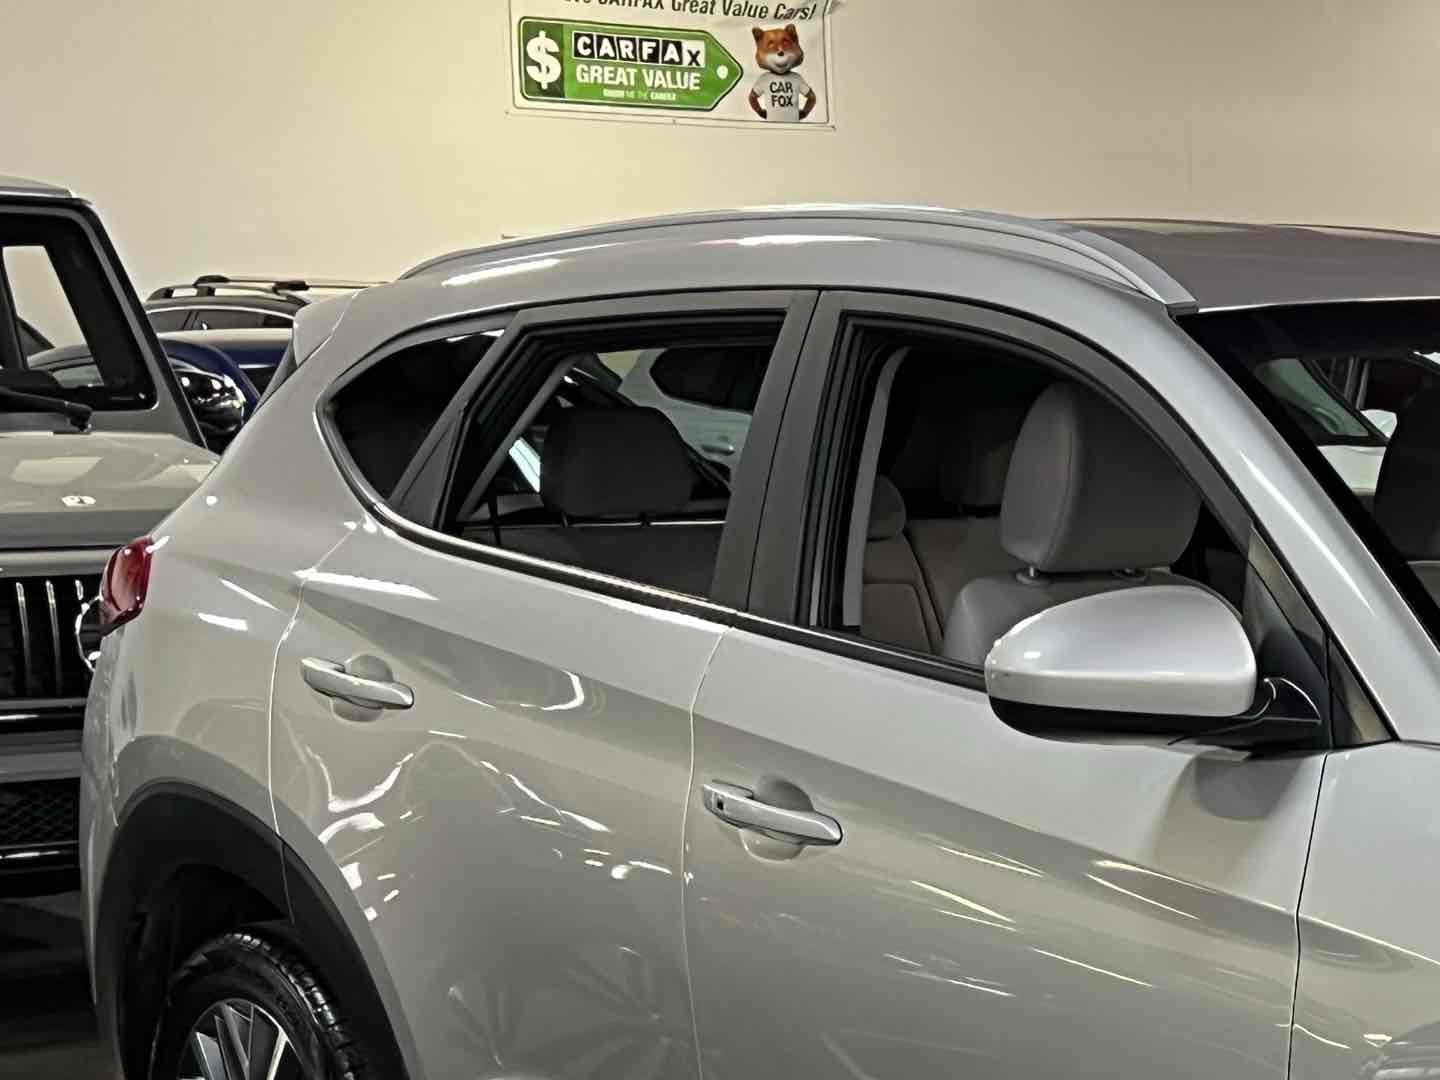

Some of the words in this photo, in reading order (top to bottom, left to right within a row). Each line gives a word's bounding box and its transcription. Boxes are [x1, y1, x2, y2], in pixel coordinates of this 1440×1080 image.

[671, 0, 716, 15] Great
[722, 0, 769, 19] Value
[773, 3, 817, 21] Cars!
[576, 35, 702, 67] CARFAX
[575, 63, 638, 87] GREAT
[642, 68, 701, 91] VALUE
[769, 81, 793, 94] CAR
[771, 95, 793, 107] FOX
